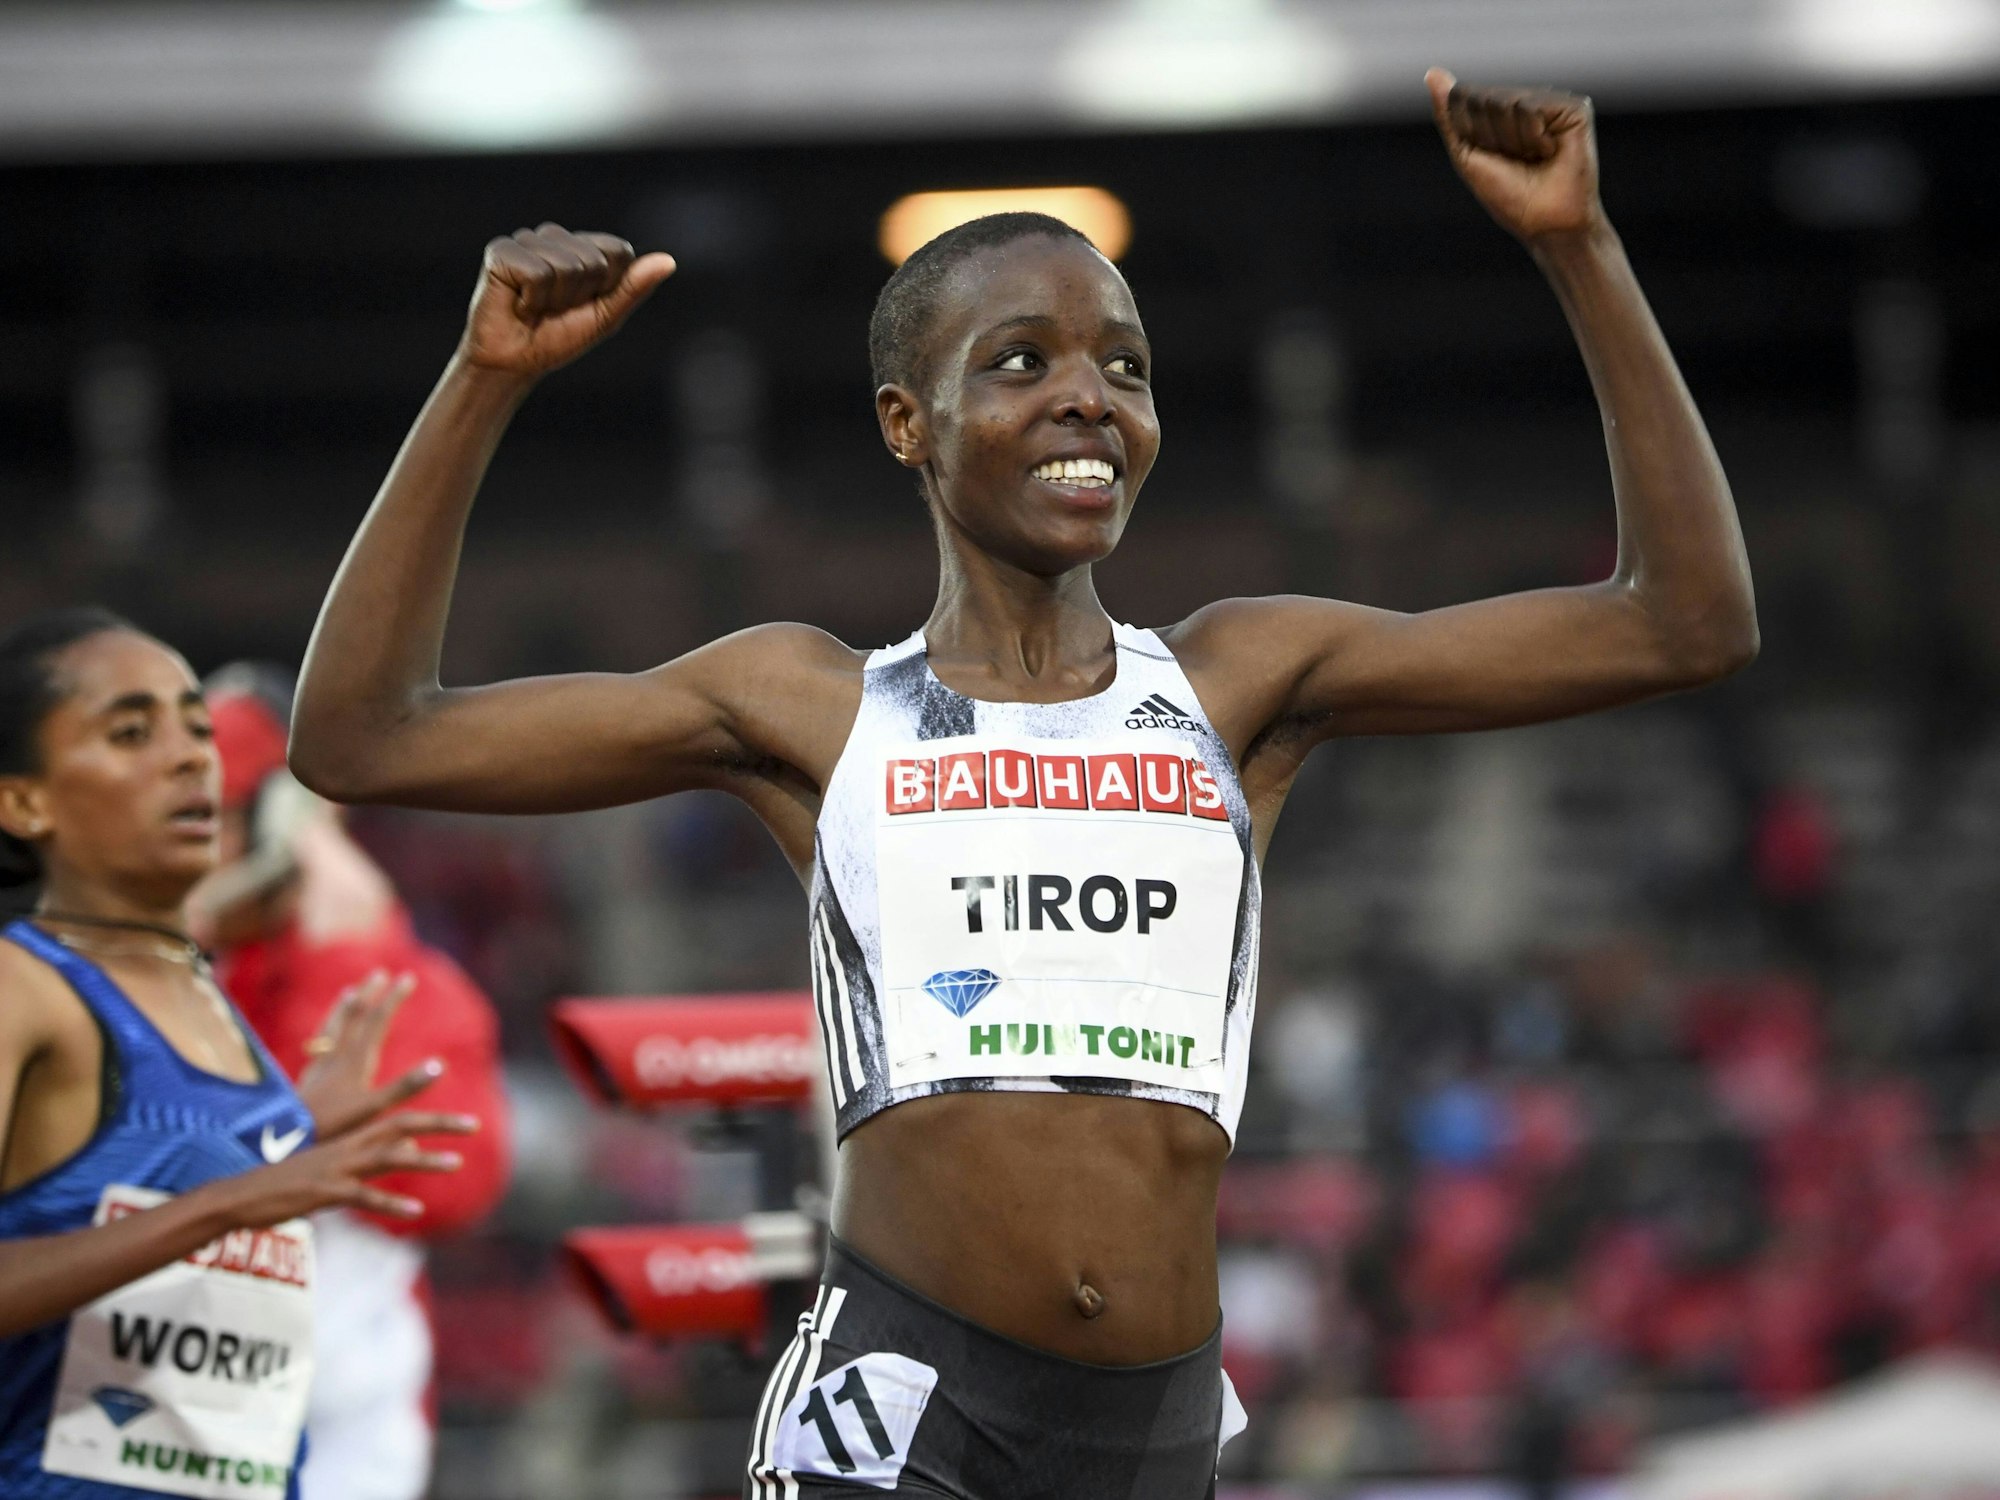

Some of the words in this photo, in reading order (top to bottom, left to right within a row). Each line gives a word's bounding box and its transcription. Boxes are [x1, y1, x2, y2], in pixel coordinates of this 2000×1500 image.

[1124, 714, 1208, 736] adidas
[893, 756, 1222, 809] BAUHAUS
[951, 873, 1178, 935] TIROP
[798, 1365, 895, 1475] 11
[121, 1438, 290, 1486] HUNTON
